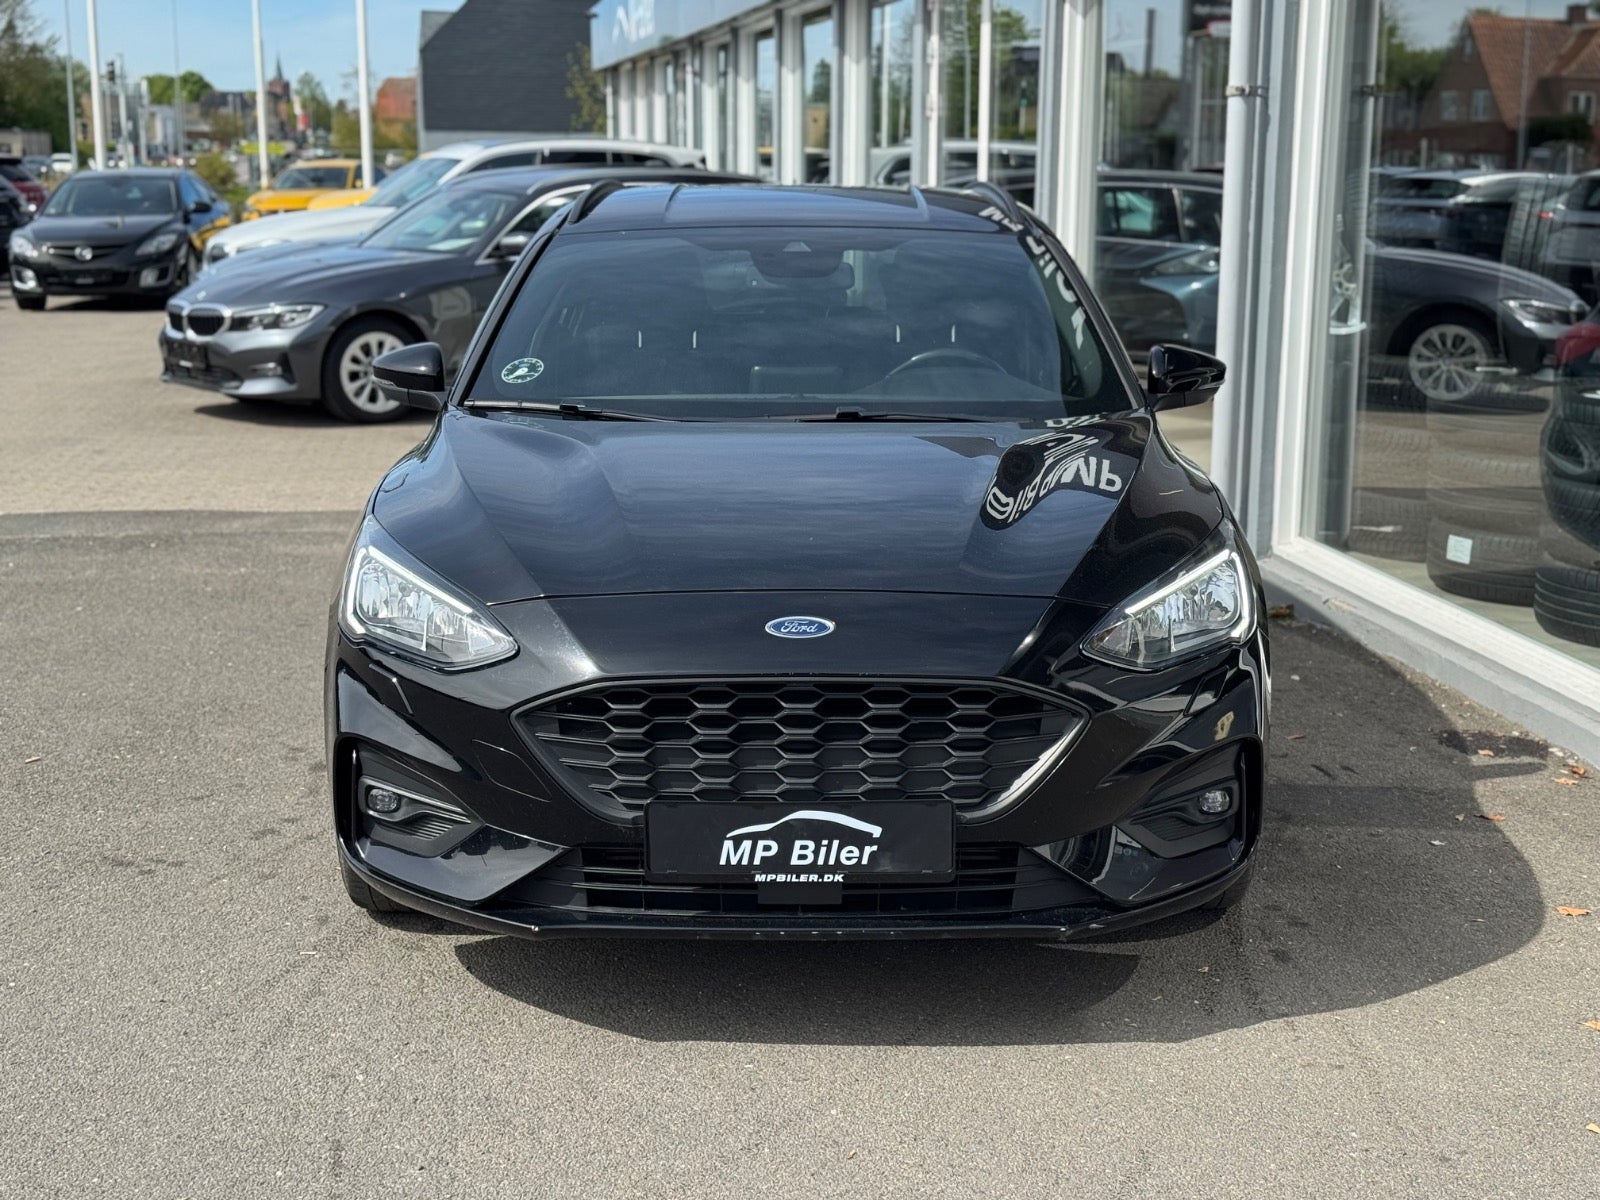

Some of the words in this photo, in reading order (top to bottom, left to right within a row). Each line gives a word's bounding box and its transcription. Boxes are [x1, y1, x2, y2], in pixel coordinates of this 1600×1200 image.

[780, 620, 818, 633] Ford
[719, 839, 779, 866] MP
[790, 839, 878, 866] Biler
[754, 873, 845, 882] MPBILER.DK
